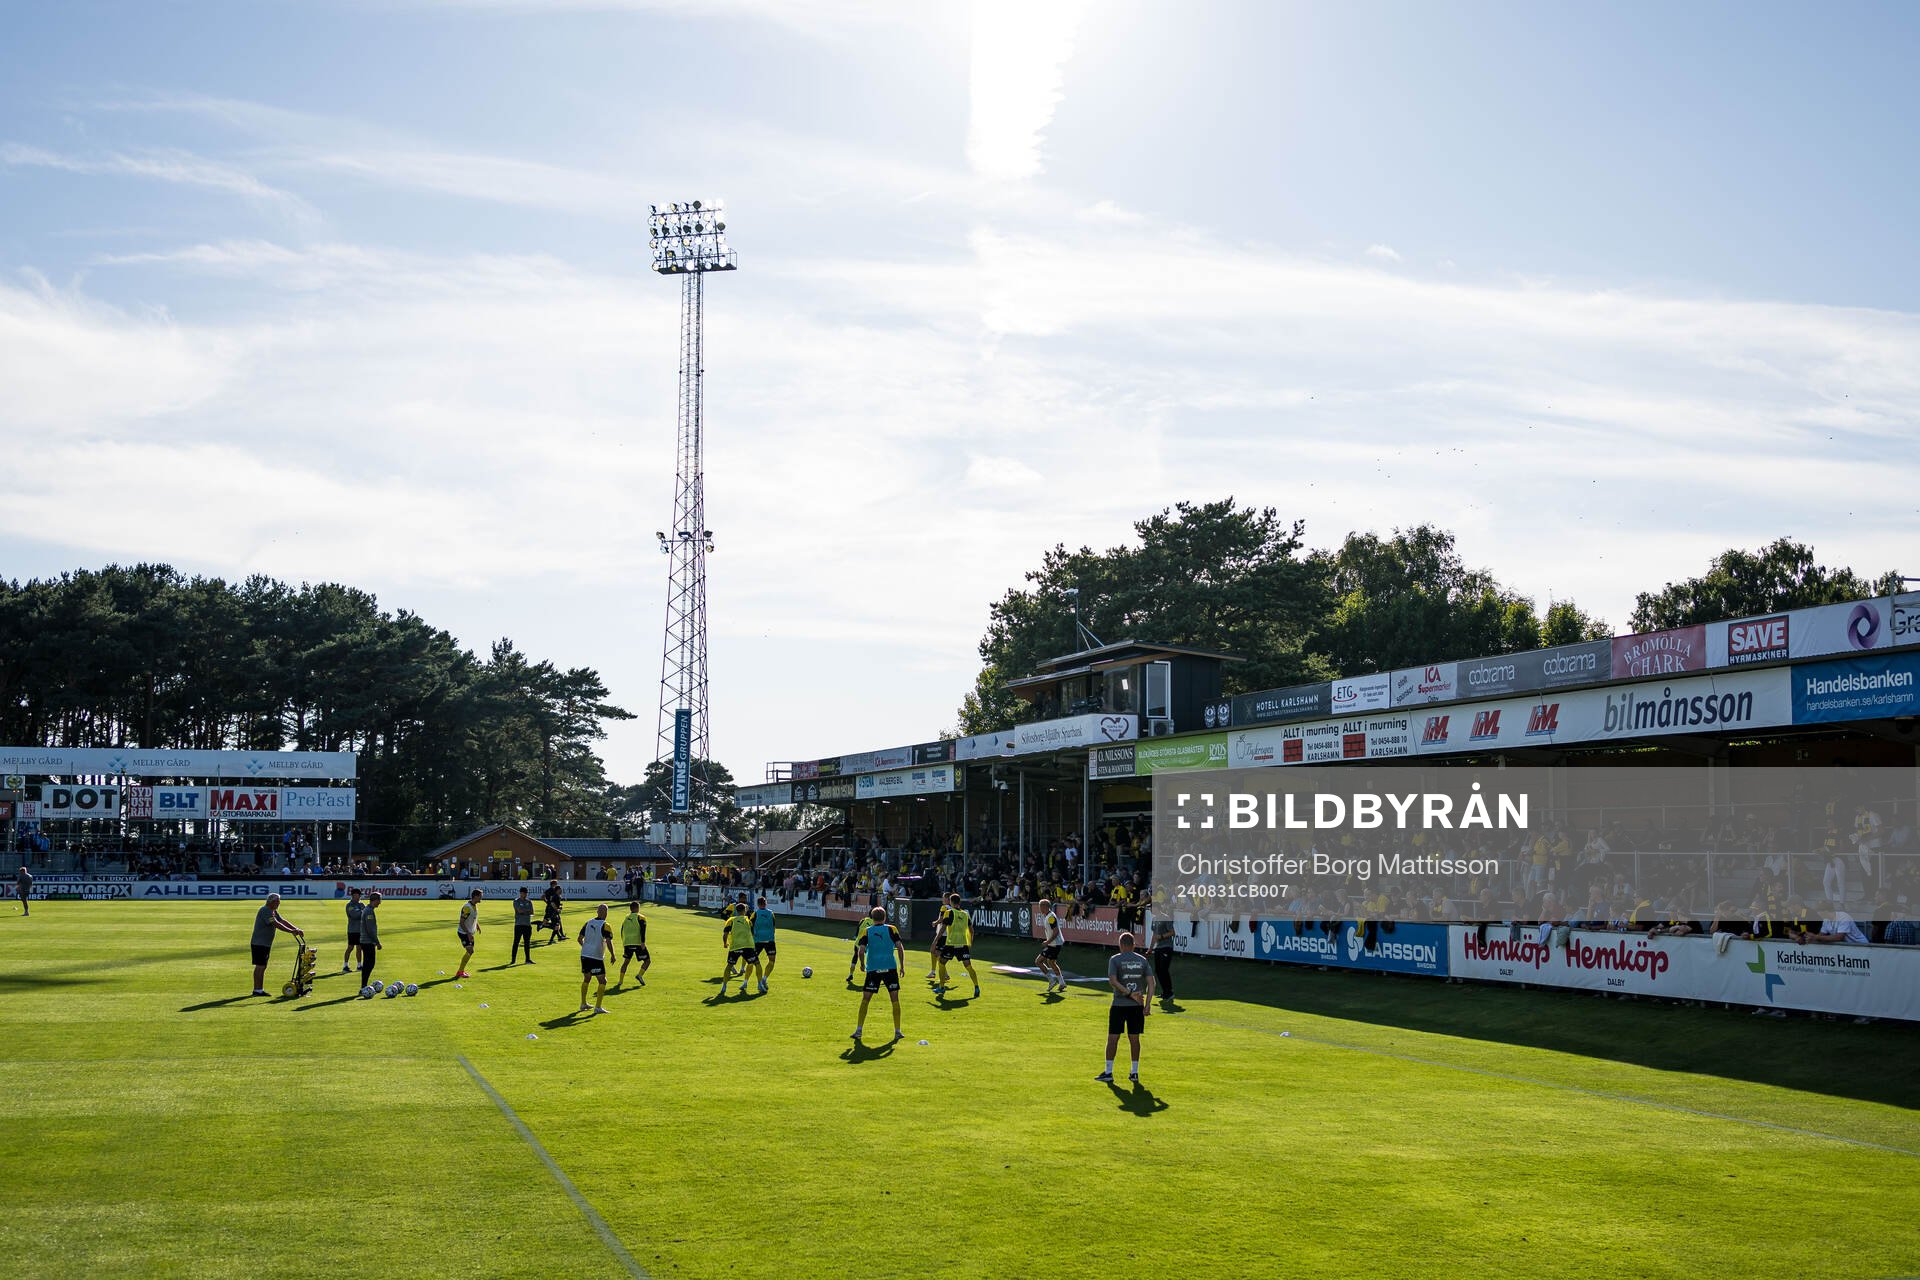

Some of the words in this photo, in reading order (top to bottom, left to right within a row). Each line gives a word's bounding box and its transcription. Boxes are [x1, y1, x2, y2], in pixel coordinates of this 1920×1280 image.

[1623, 634, 1691, 664] BROMÖLLA
[1730, 650, 1787, 664] HYRMASKINER
[1543, 652, 1596, 675] colorama
[1631, 654, 1686, 677] CHARK
[1425, 667, 1441, 683] ICA
[1469, 664, 1515, 685] colorama
[1806, 670, 1913, 695] Handelsbanken
[1337, 685, 1353, 699] ETG
[1418, 681, 1451, 694] Supermarket
[1256, 700, 1278, 711] HOTELL
[1281, 694, 1319, 707] KARLSHAMN
[1603, 687, 1753, 732] bilmånsson
[1807, 693, 1914, 711] handelsbanken.se/karlshamn
[1283, 728, 1300, 739] ALLT
[1302, 727, 1305, 737] i
[1306, 725, 1339, 737] murning
[1342, 721, 1363, 734] ALLT
[1364, 720, 1367, 731] i
[1370, 718, 1407, 731] murning
[1333, 740, 1339, 748] 10
[1371, 747, 1408, 757] KARLSHAMN
[3, 757, 37, 765] MELLBY
[38, 756, 63, 765] GÅRD
[132, 759, 165, 767] MELLBY
[166, 758, 191, 767] GÅRD
[1105, 748, 1133, 761] NILSSONS
[1307, 751, 1340, 761] KARLSHAMN
[300, 760, 324, 768] GÅRD
[131, 787, 152, 797] SYD
[159, 792, 199, 808] BLT
[210, 789, 277, 811] MAXI
[286, 791, 352, 807] PreFast
[130, 807, 151, 817] RAN
[144, 885, 269, 896] AHLBERG
[279, 885, 318, 896] BIL
[346, 885, 428, 897] Brgkvarabuss
[1001, 911, 1013, 928] AIF
[1076, 917, 1113, 935] Sölvesborgs
[1223, 935, 1246, 956] Group
[1276, 935, 1338, 955] LARSSON
[1365, 942, 1437, 963] LARSSON
[1464, 932, 1550, 969] Hemköp
[1566, 938, 1669, 980] Hemköp
[1777, 950, 1835, 967] Karlshamns
[1837, 954, 1870, 969] Hamn
[1607, 978, 1625, 987] DALBY
